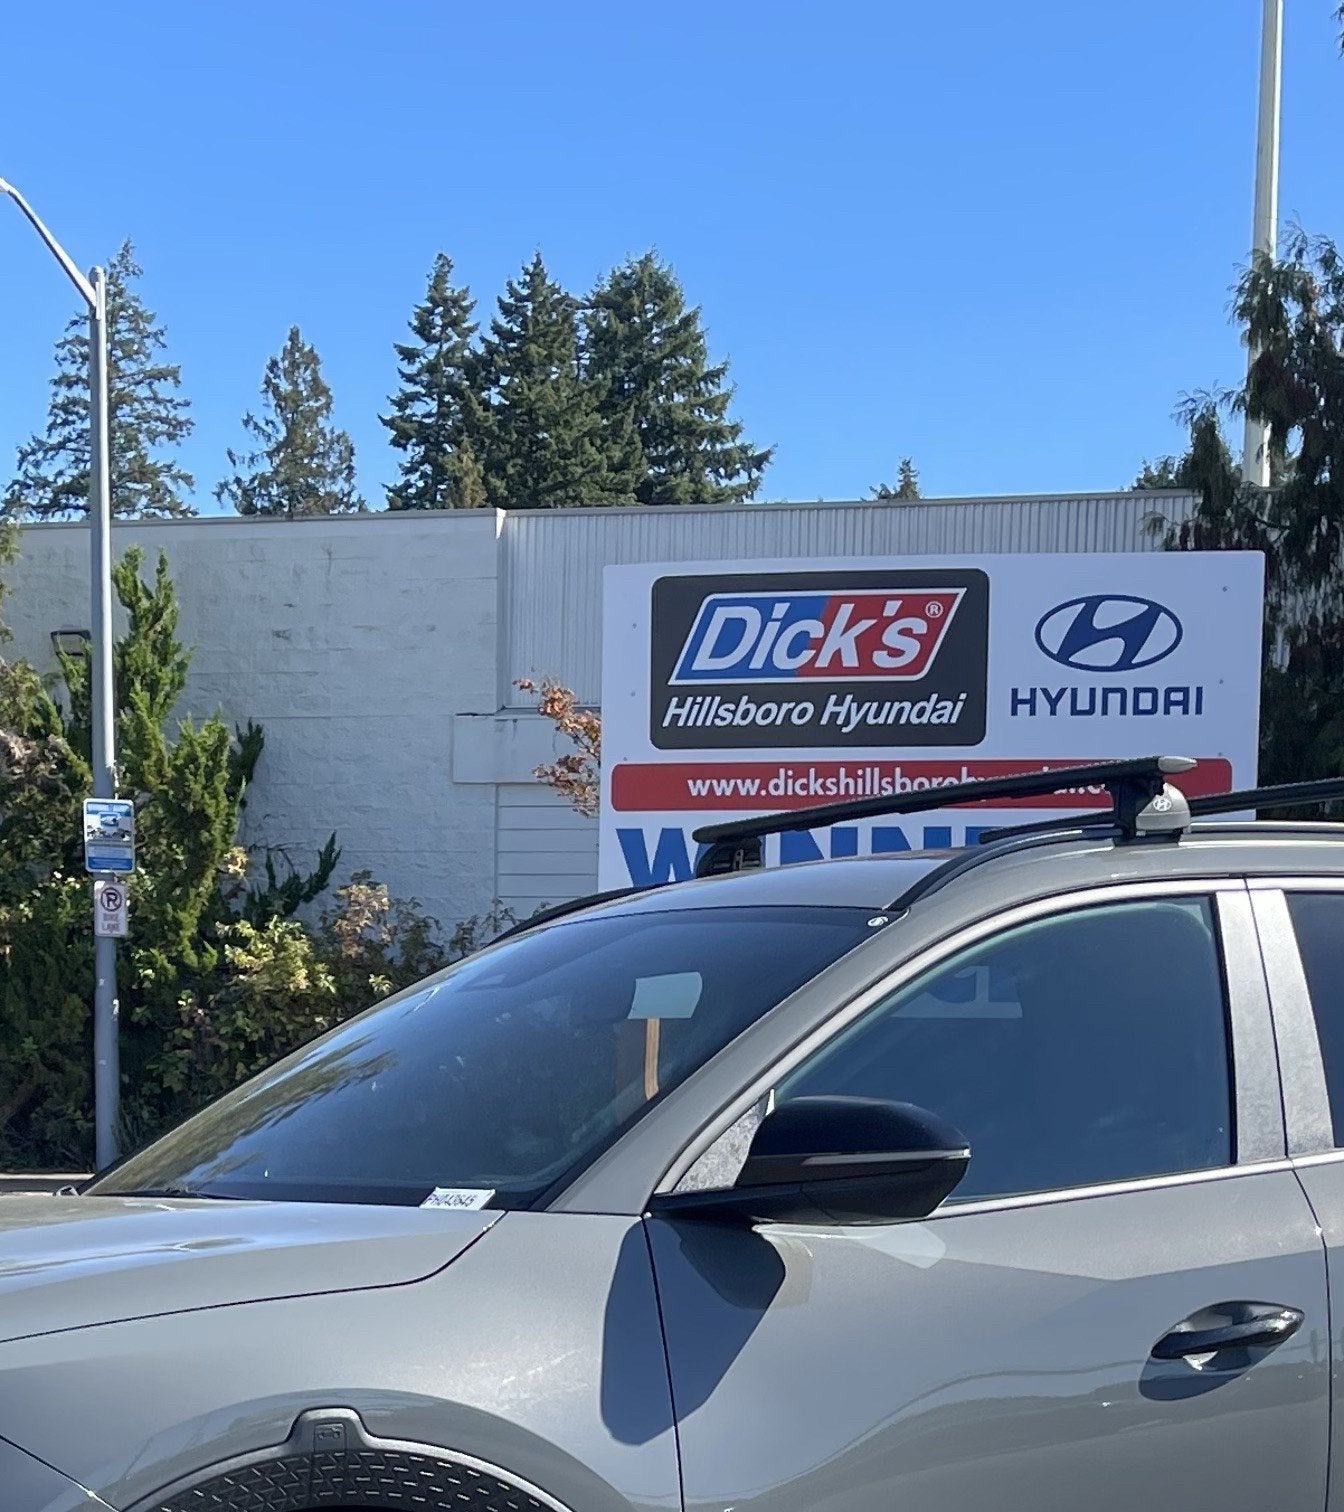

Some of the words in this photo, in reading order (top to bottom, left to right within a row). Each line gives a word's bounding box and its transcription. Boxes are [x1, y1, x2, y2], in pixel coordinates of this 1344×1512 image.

[691, 600, 928, 672] Dick's
[662, 695, 814, 728] Hillsboro
[820, 693, 968, 734] Hyundai
[1010, 686, 1204, 717] HYUNDAI
